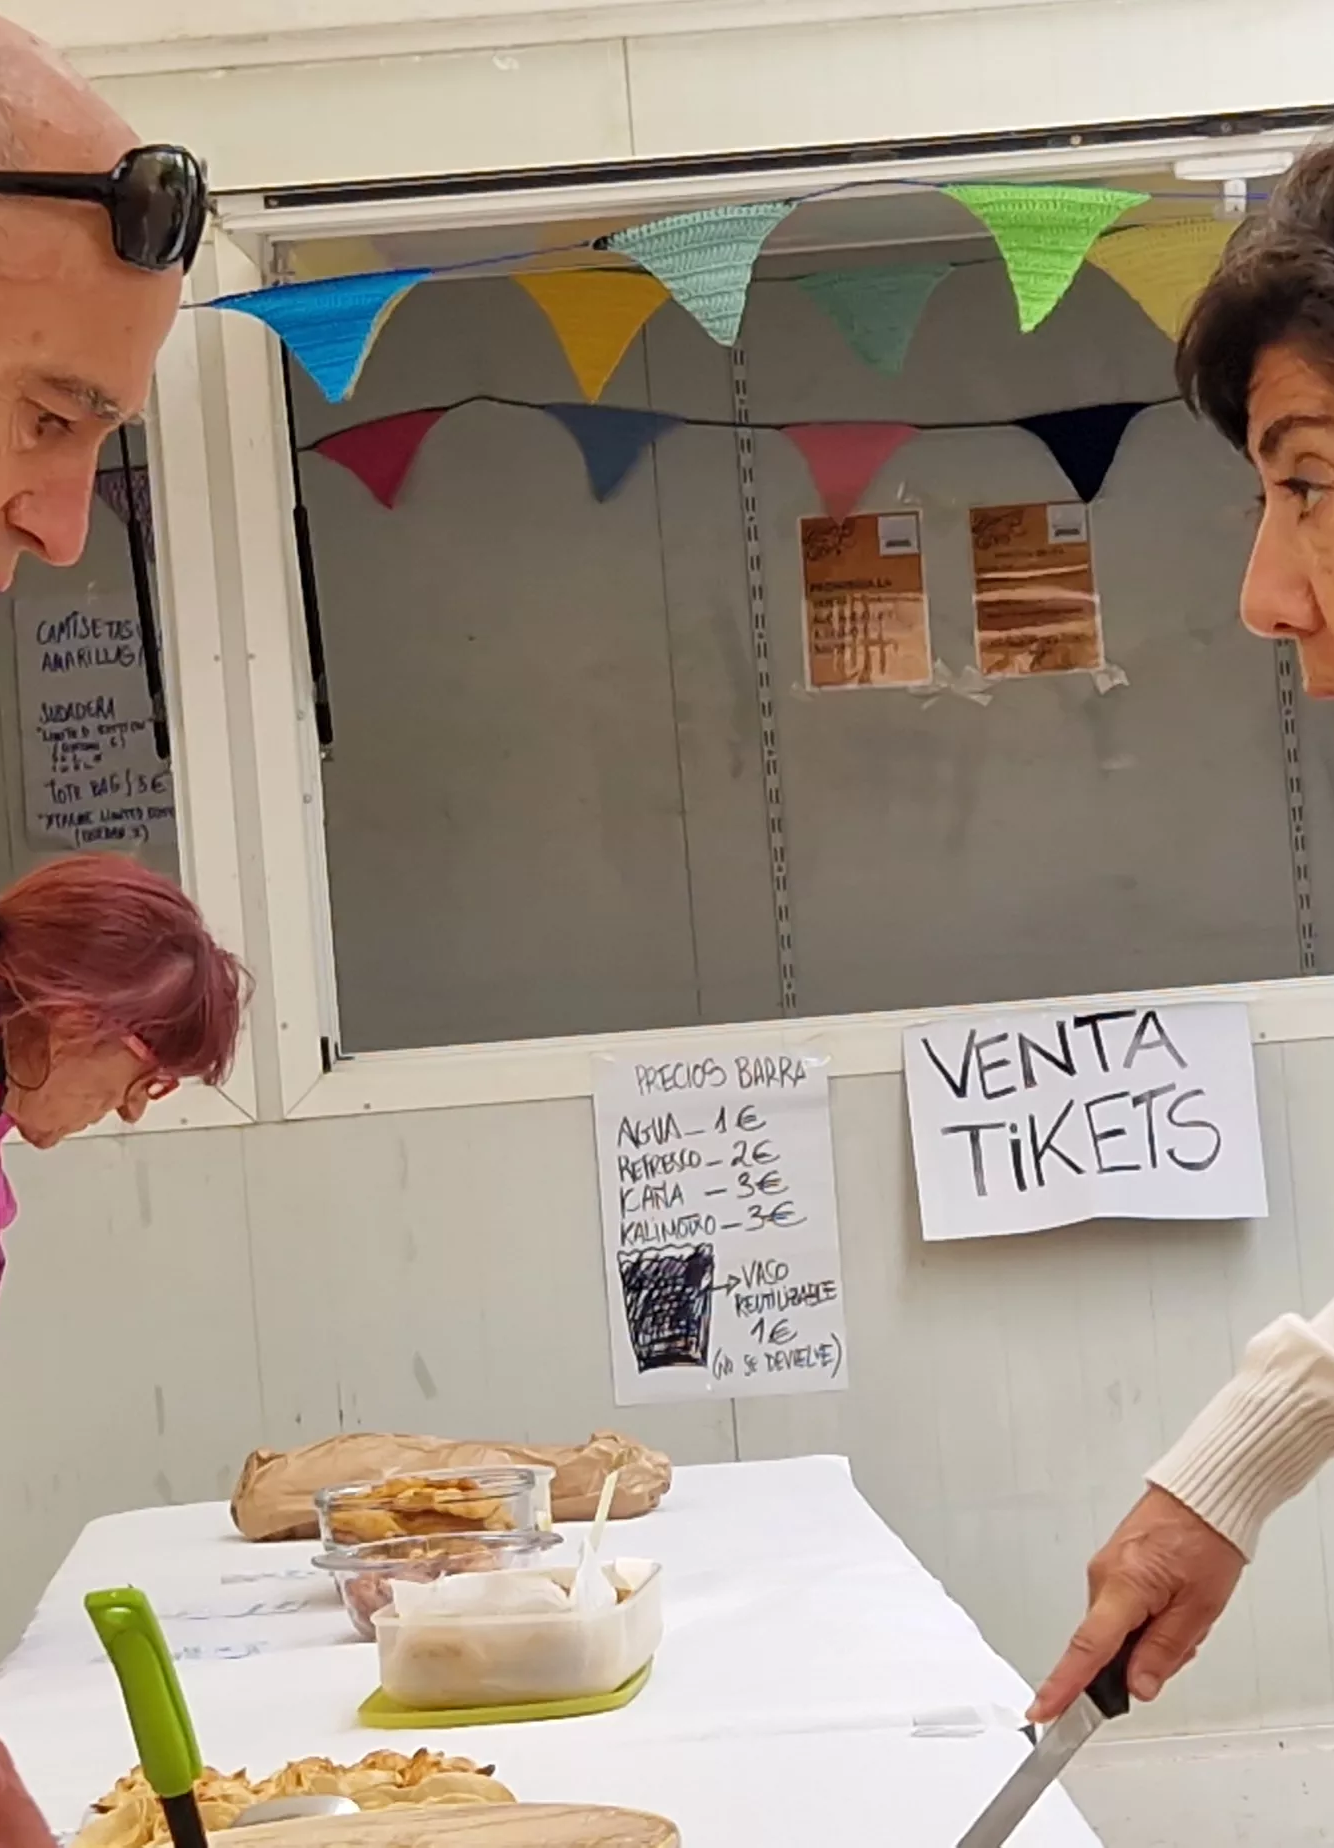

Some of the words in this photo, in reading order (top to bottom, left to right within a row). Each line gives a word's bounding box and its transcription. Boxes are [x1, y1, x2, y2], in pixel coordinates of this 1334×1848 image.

[921, 1010, 1188, 1100] VENTA
[635, 1058, 727, 1096] PRECIOS
[735, 1054, 807, 1090] BARRA
[617, 1112, 682, 1148] AGUA
[618, 1150, 702, 1182] REFRESCO
[741, 1259, 790, 1291] VASO
